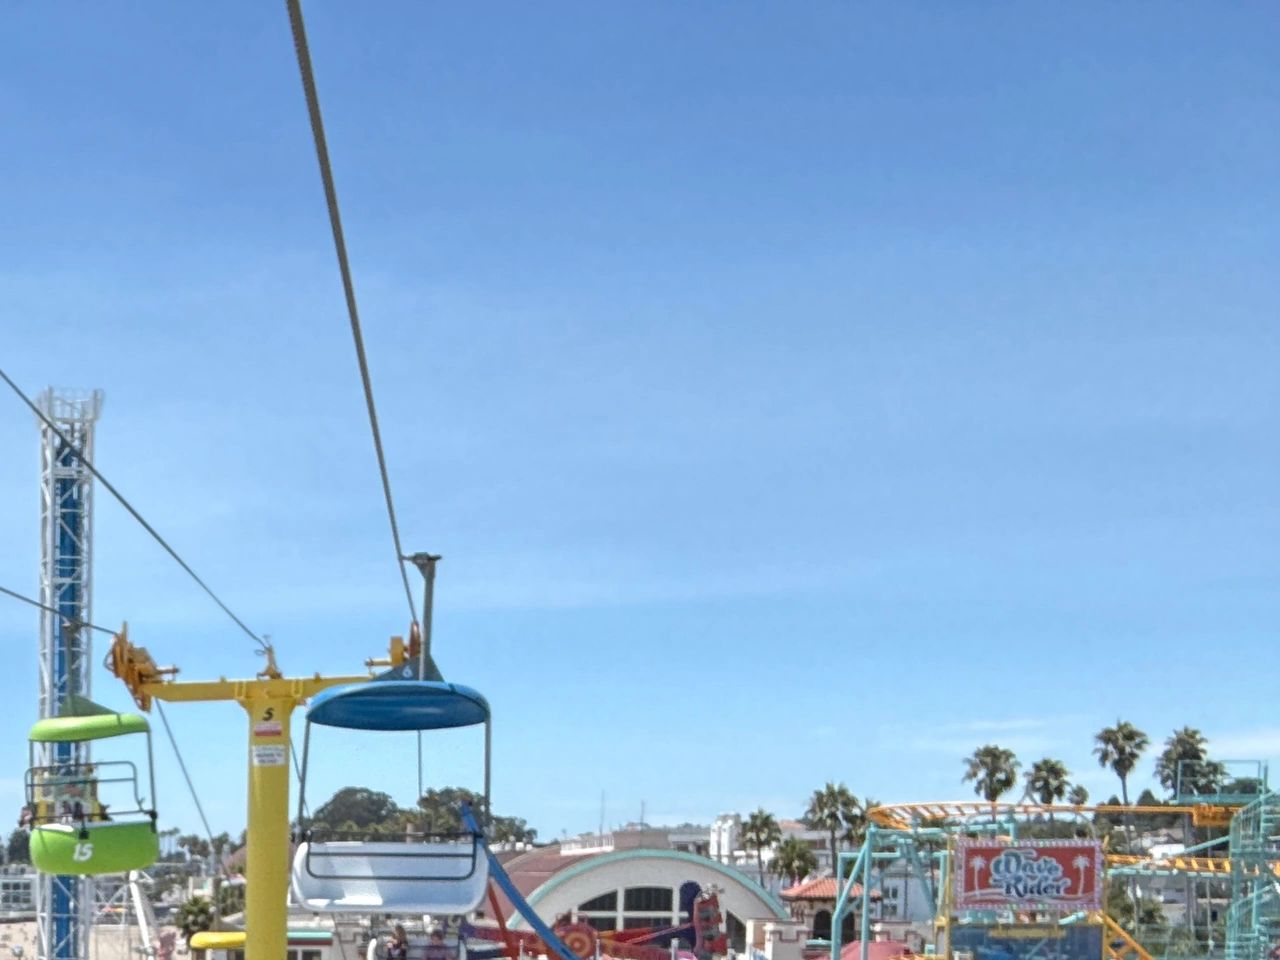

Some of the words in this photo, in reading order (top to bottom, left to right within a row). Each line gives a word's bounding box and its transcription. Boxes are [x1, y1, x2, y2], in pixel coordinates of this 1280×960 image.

[72, 842, 94, 862] 15
[991, 850, 1064, 877] Wave
[991, 870, 1071, 897] Rider
